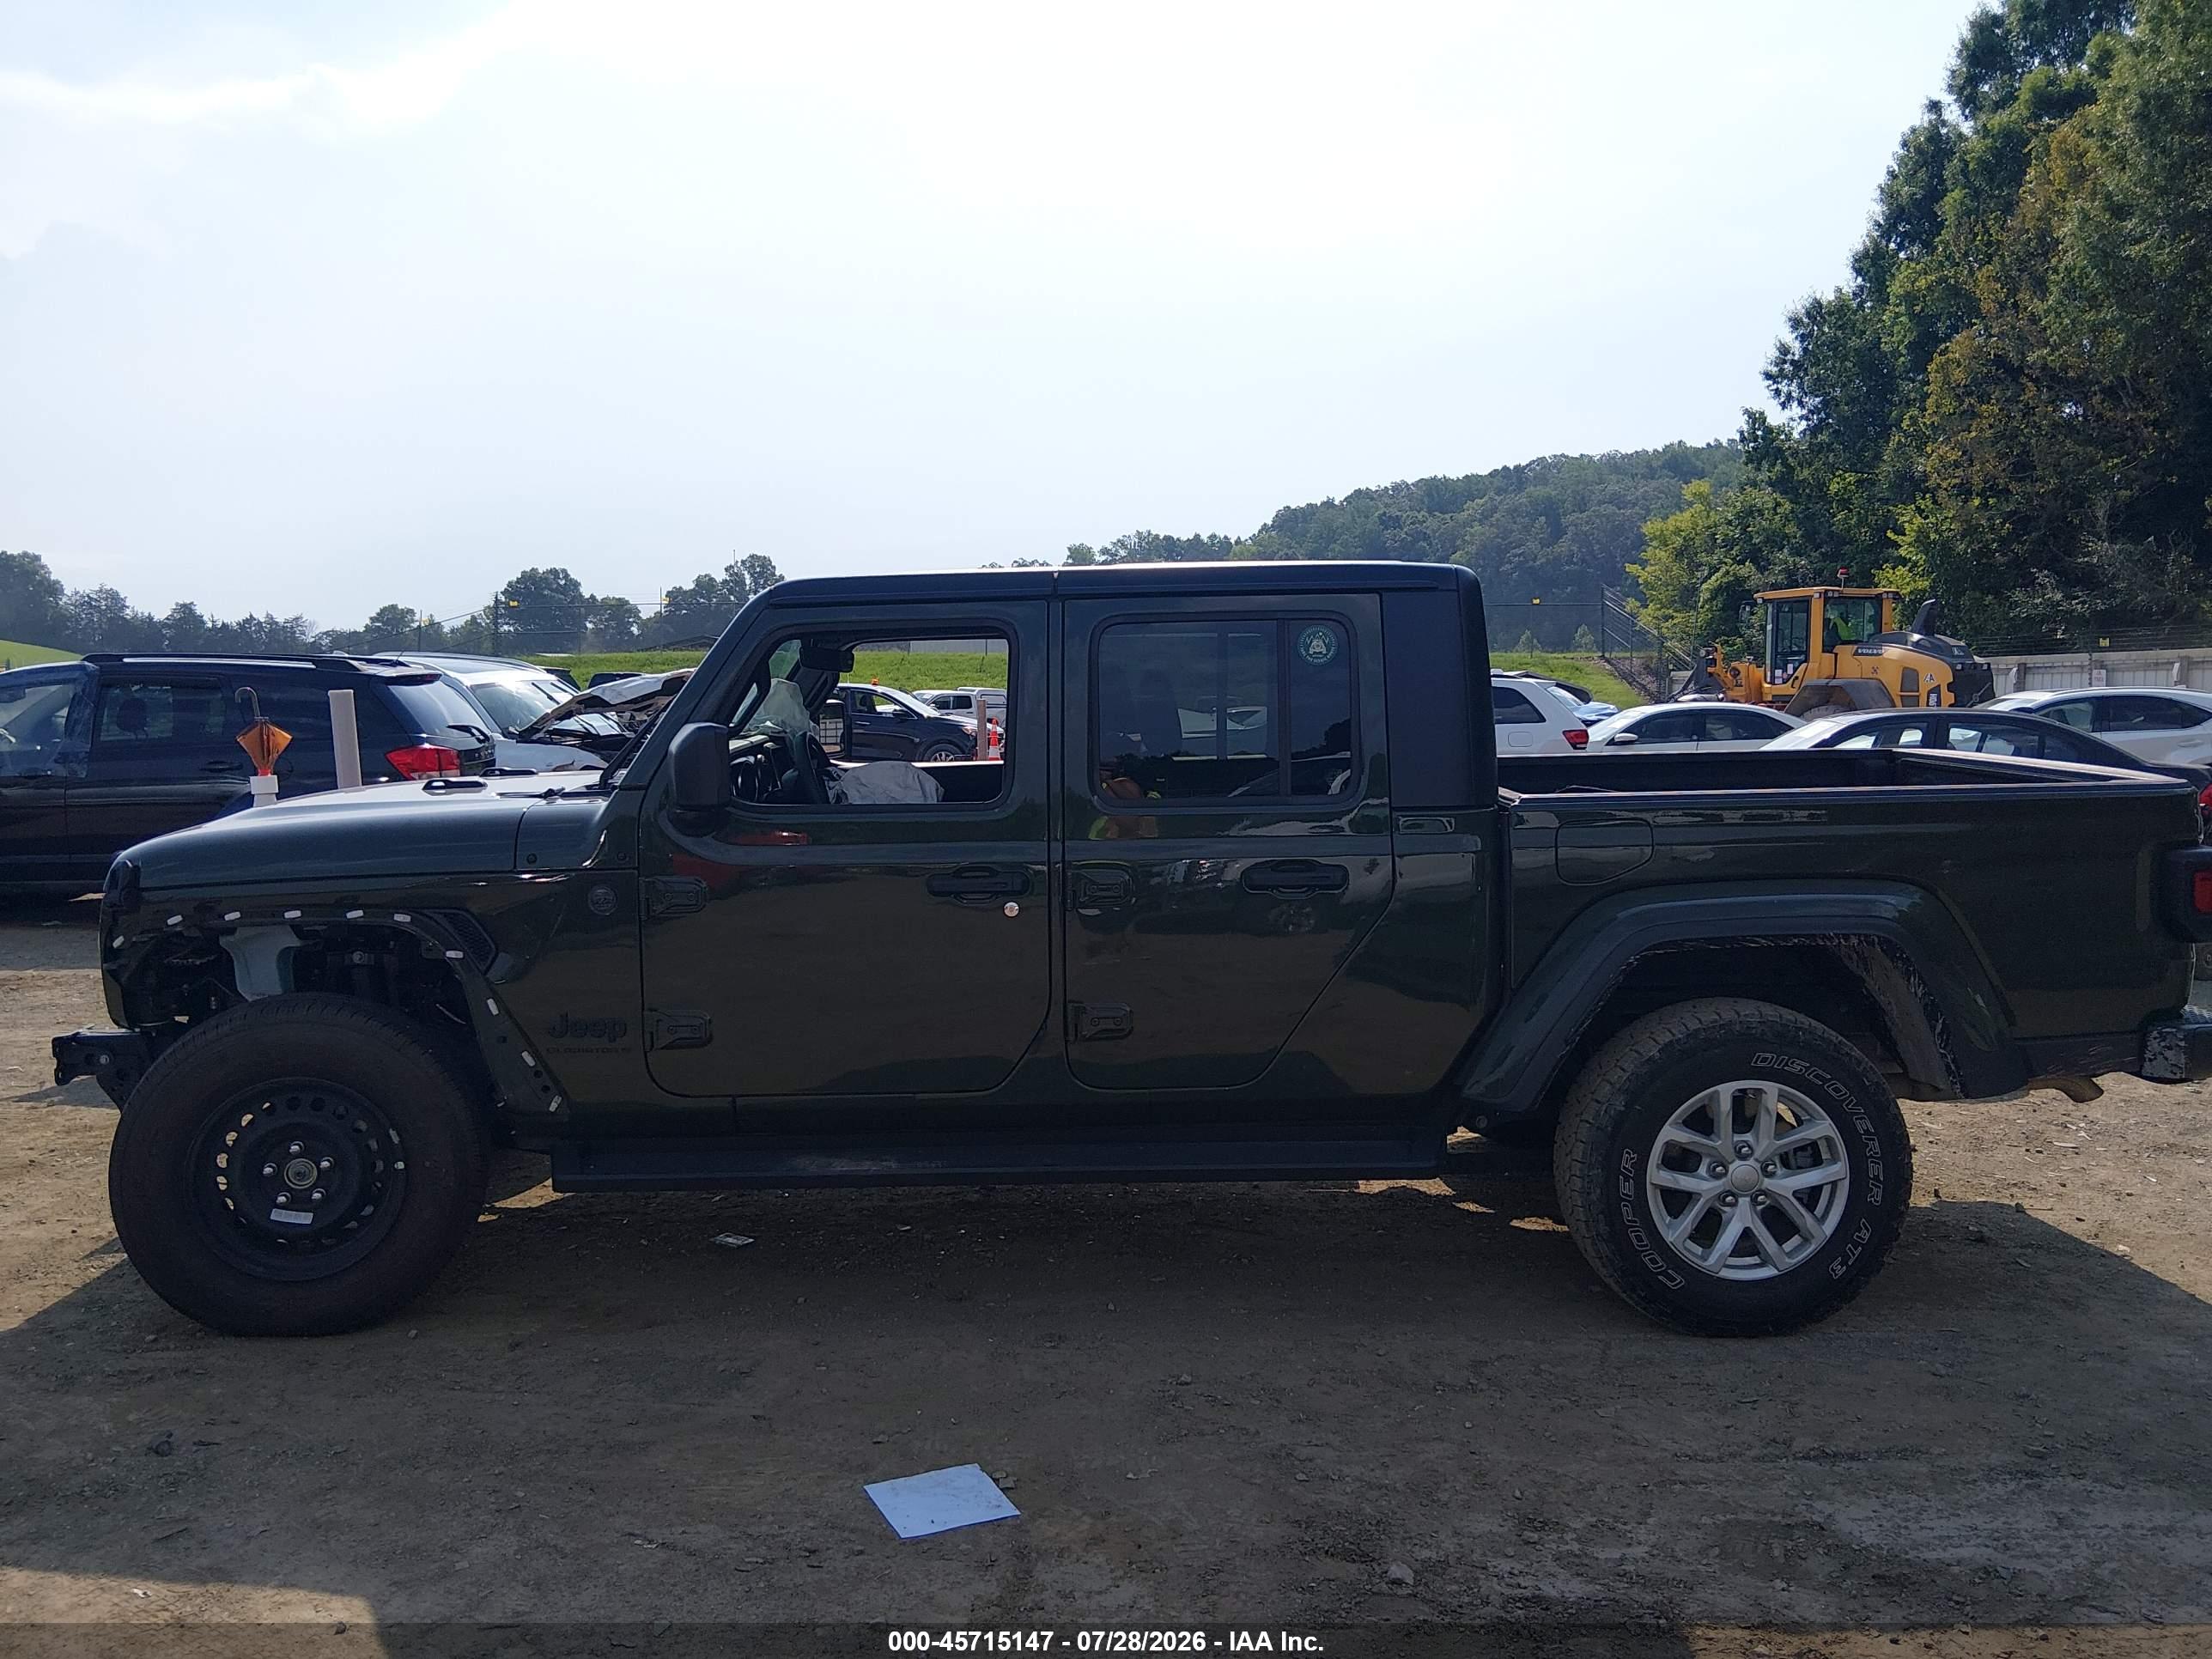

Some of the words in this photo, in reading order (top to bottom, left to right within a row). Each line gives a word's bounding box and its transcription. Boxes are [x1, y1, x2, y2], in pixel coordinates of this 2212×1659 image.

[548, 1010, 628, 1043] Jeep
[1751, 1052, 1884, 1207] DISCOVERER
[1620, 1148, 1686, 1290] COOPER
[1828, 1218, 1873, 1280] AT3
